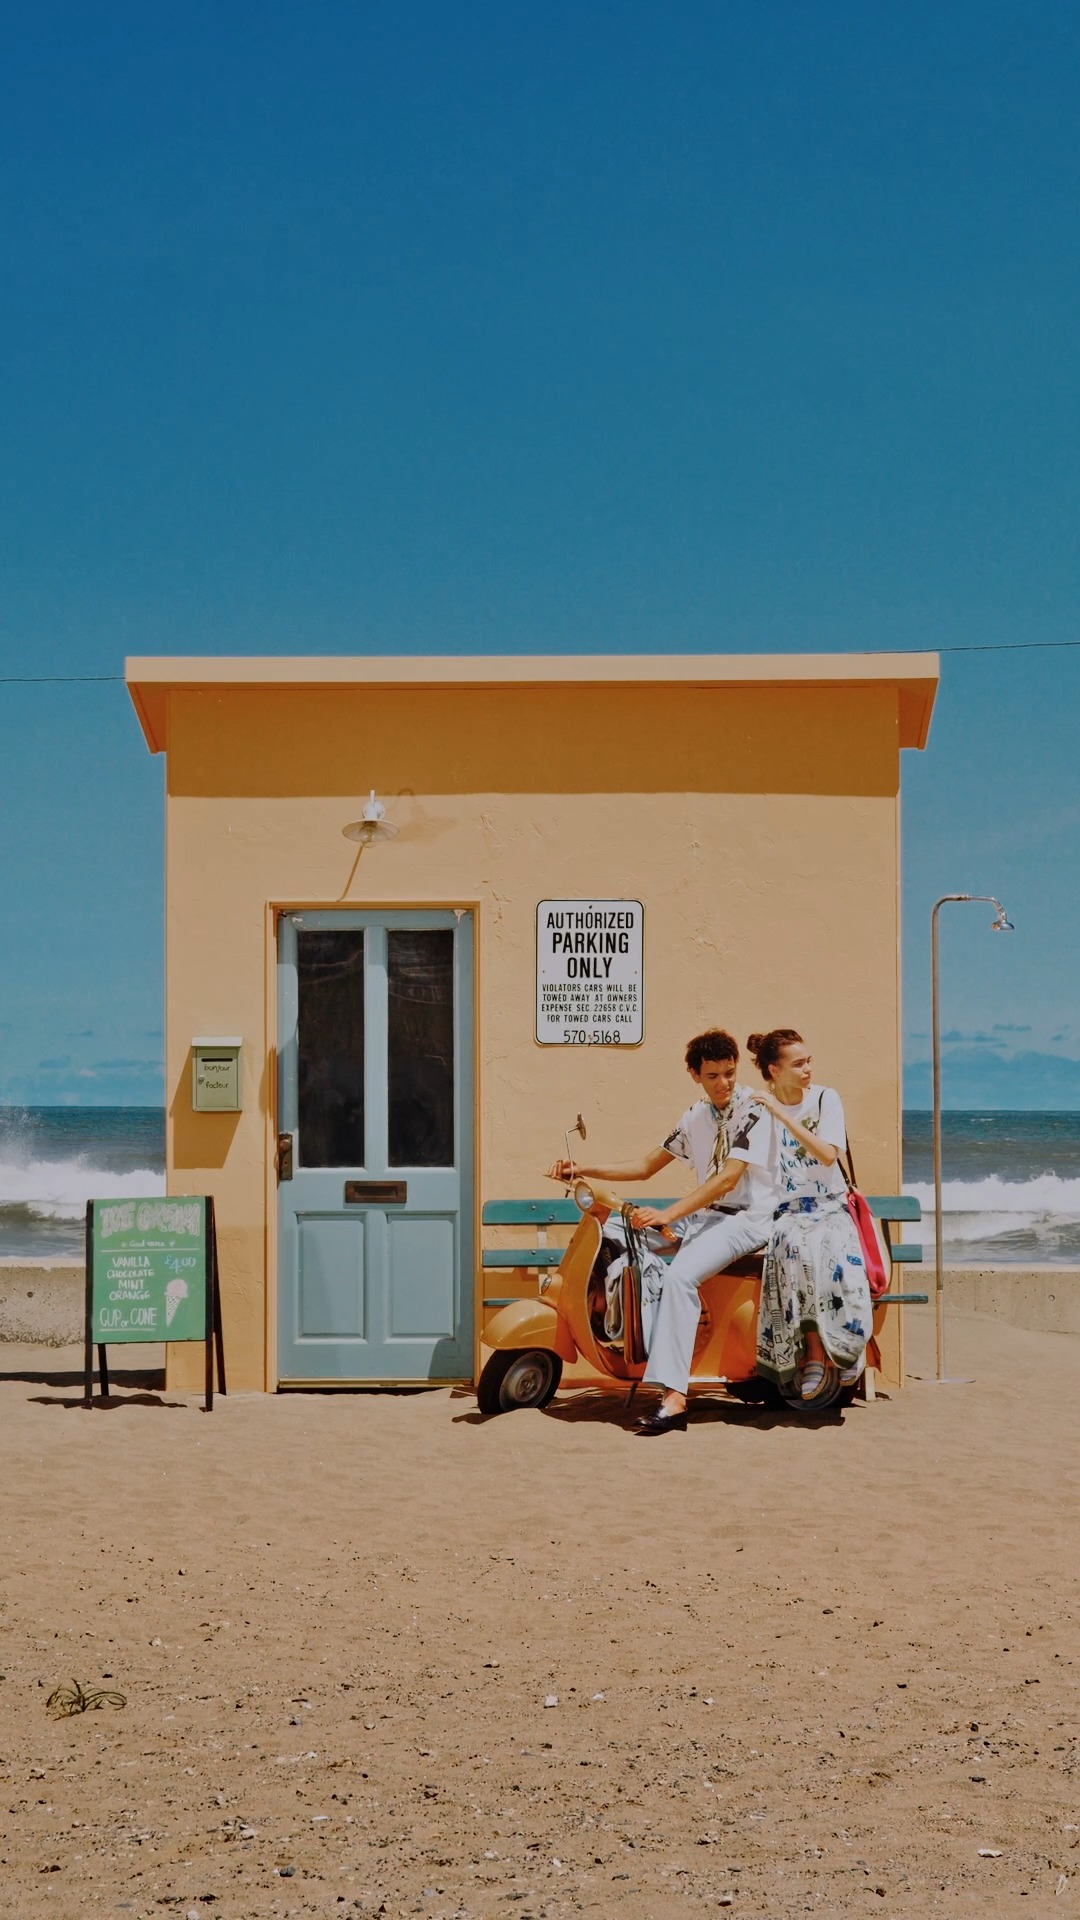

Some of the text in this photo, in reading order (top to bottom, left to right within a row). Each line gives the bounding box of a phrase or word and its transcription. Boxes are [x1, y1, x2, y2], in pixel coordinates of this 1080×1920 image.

[547, 912, 634, 929] AUTHORIZED
[552, 932, 629, 954] PARKING
[567, 957, 612, 979] ONLY
[542, 984, 637, 992] VIOLATORS CARS WILL BE
[543, 994, 638, 1002] TOWED AWAY AT OWNERS
[541, 1004, 572, 1012] EXPENSE
[594, 1004, 617, 1012] 22658
[547, 1014, 632, 1022] FOR TOWED CARS CALL
[204, 1064, 231, 1073] bonjour
[112, 1256, 151, 1268] VANILLA
[107, 1269, 155, 1279] CHOCOLATE
[118, 1280, 145, 1290] MINT
[109, 1291, 151, 1301] ORANGE
[100, 1307, 157, 1328] CUP or CONE
